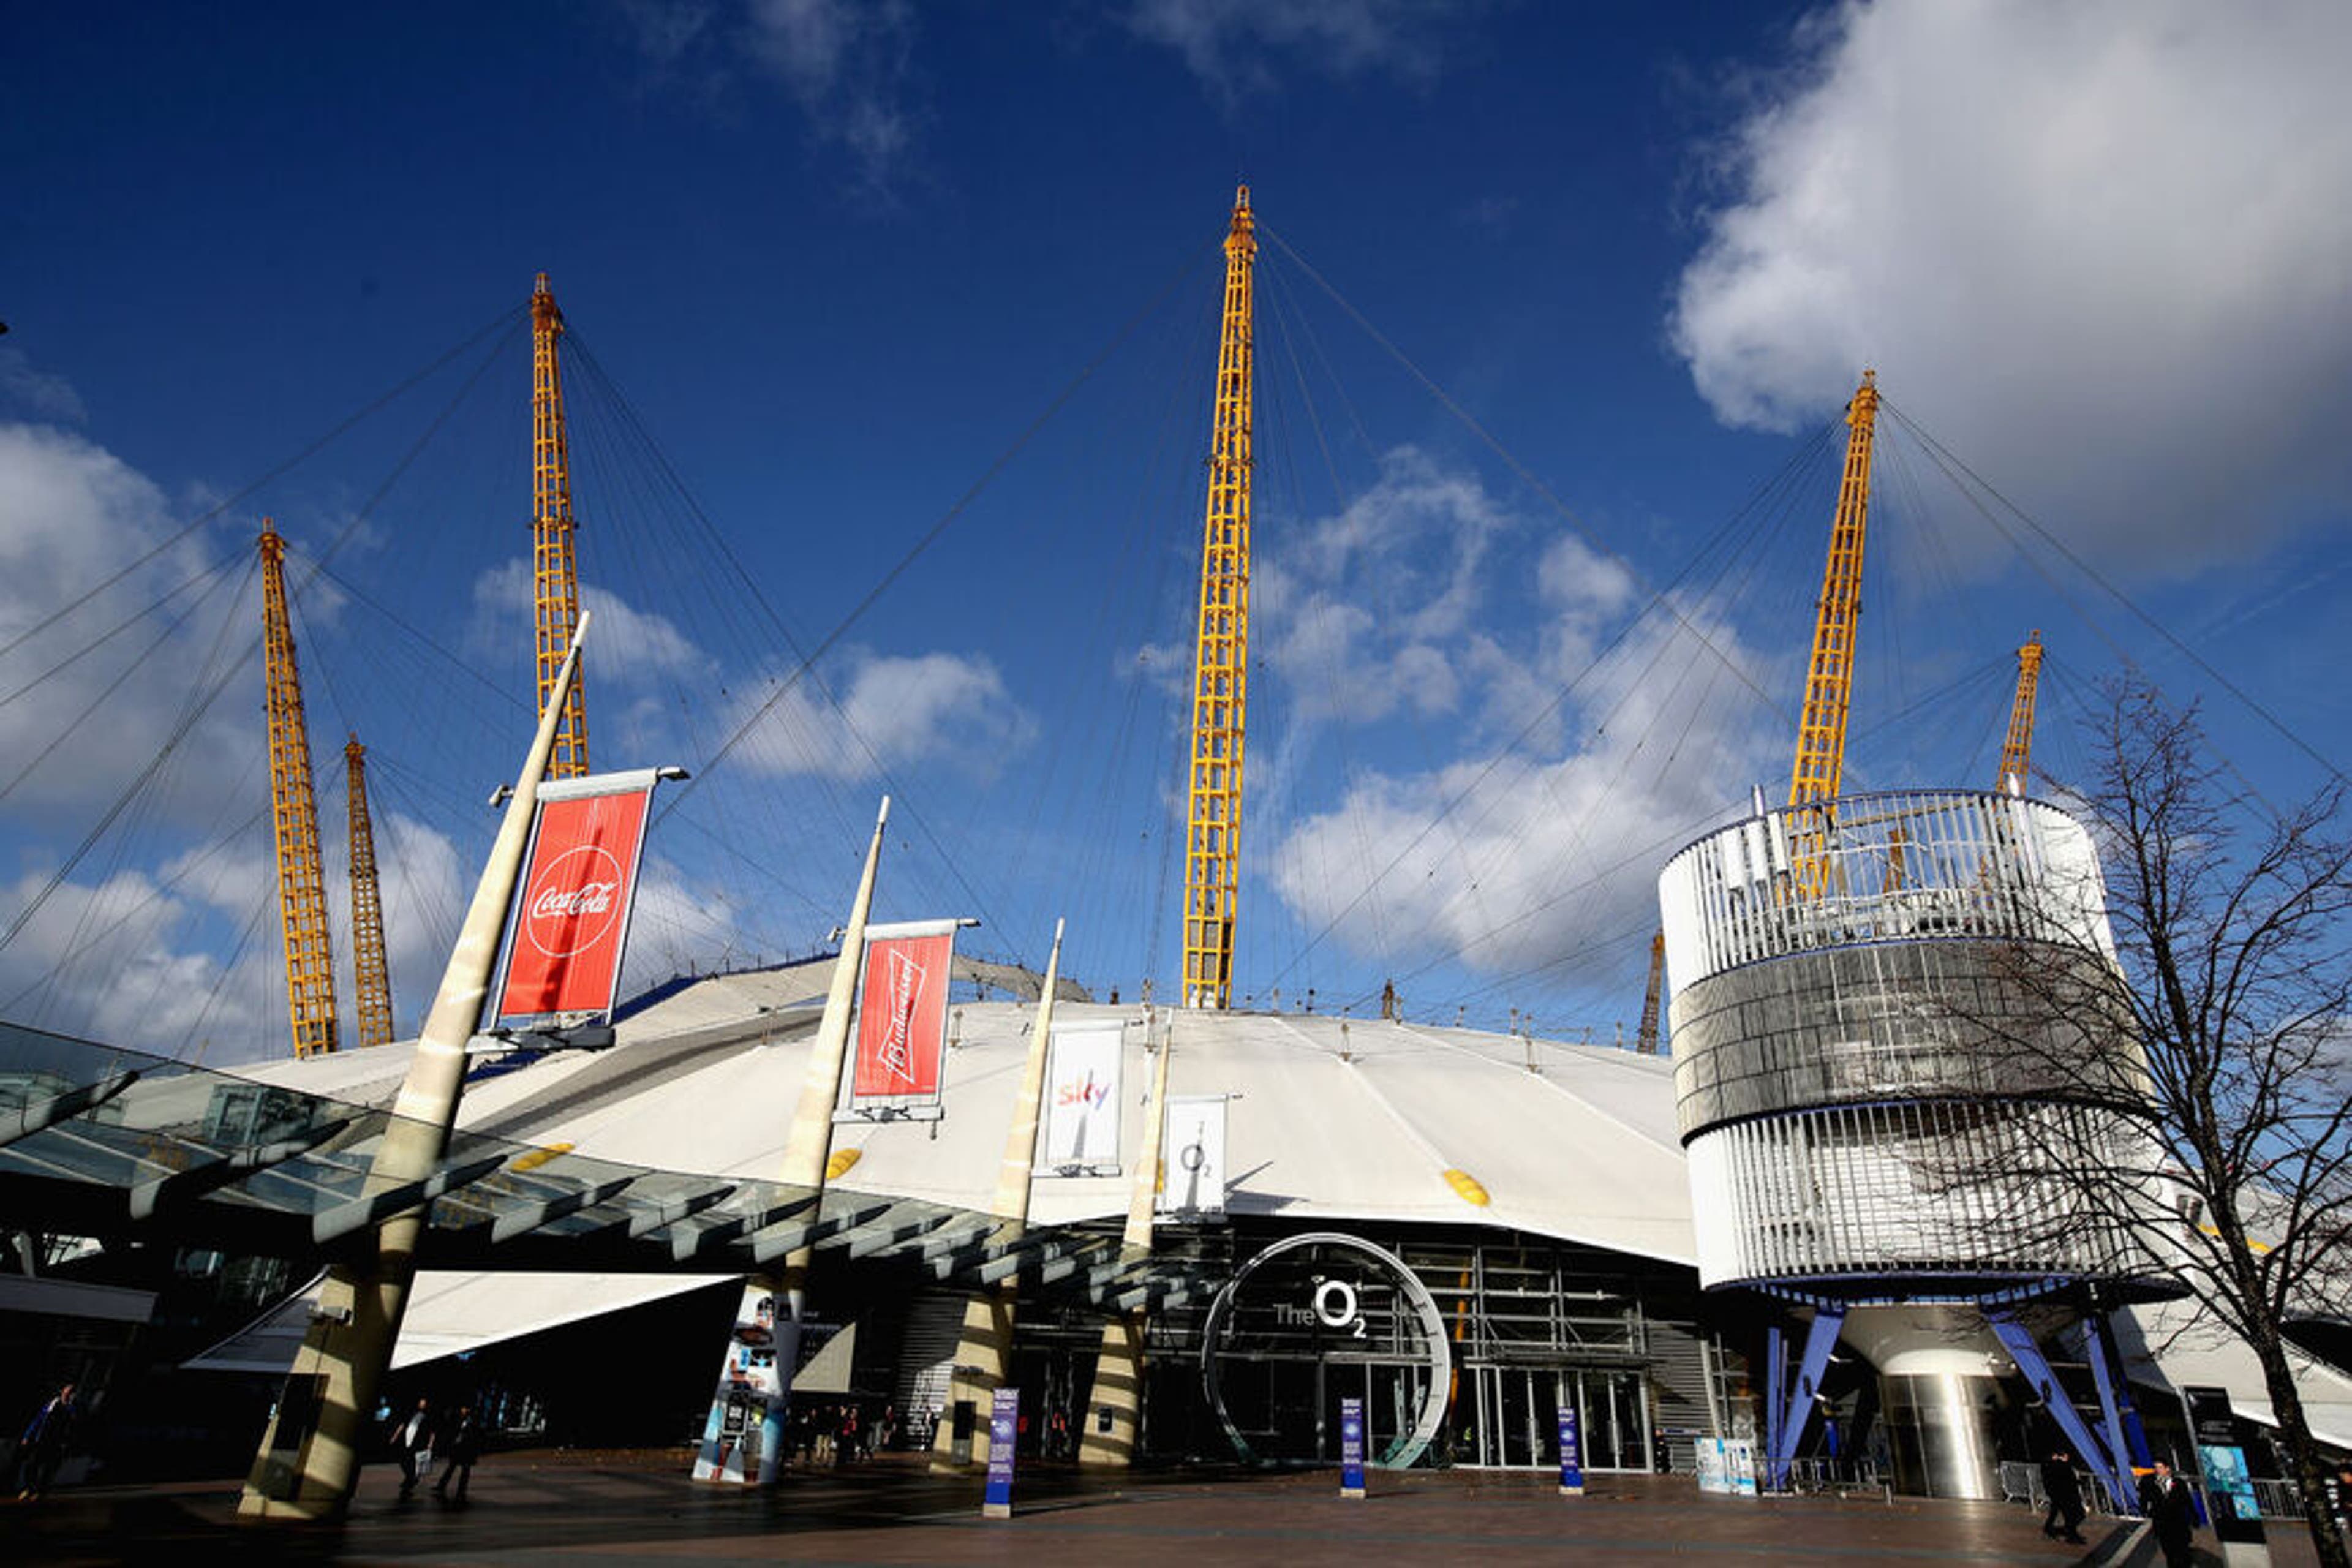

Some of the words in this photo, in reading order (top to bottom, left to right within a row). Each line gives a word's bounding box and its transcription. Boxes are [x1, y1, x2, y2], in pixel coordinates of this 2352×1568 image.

[888, 959, 913, 1069] Budweiser
[1058, 1076, 1112, 1110] sky
[1273, 1303, 1316, 1326] The
